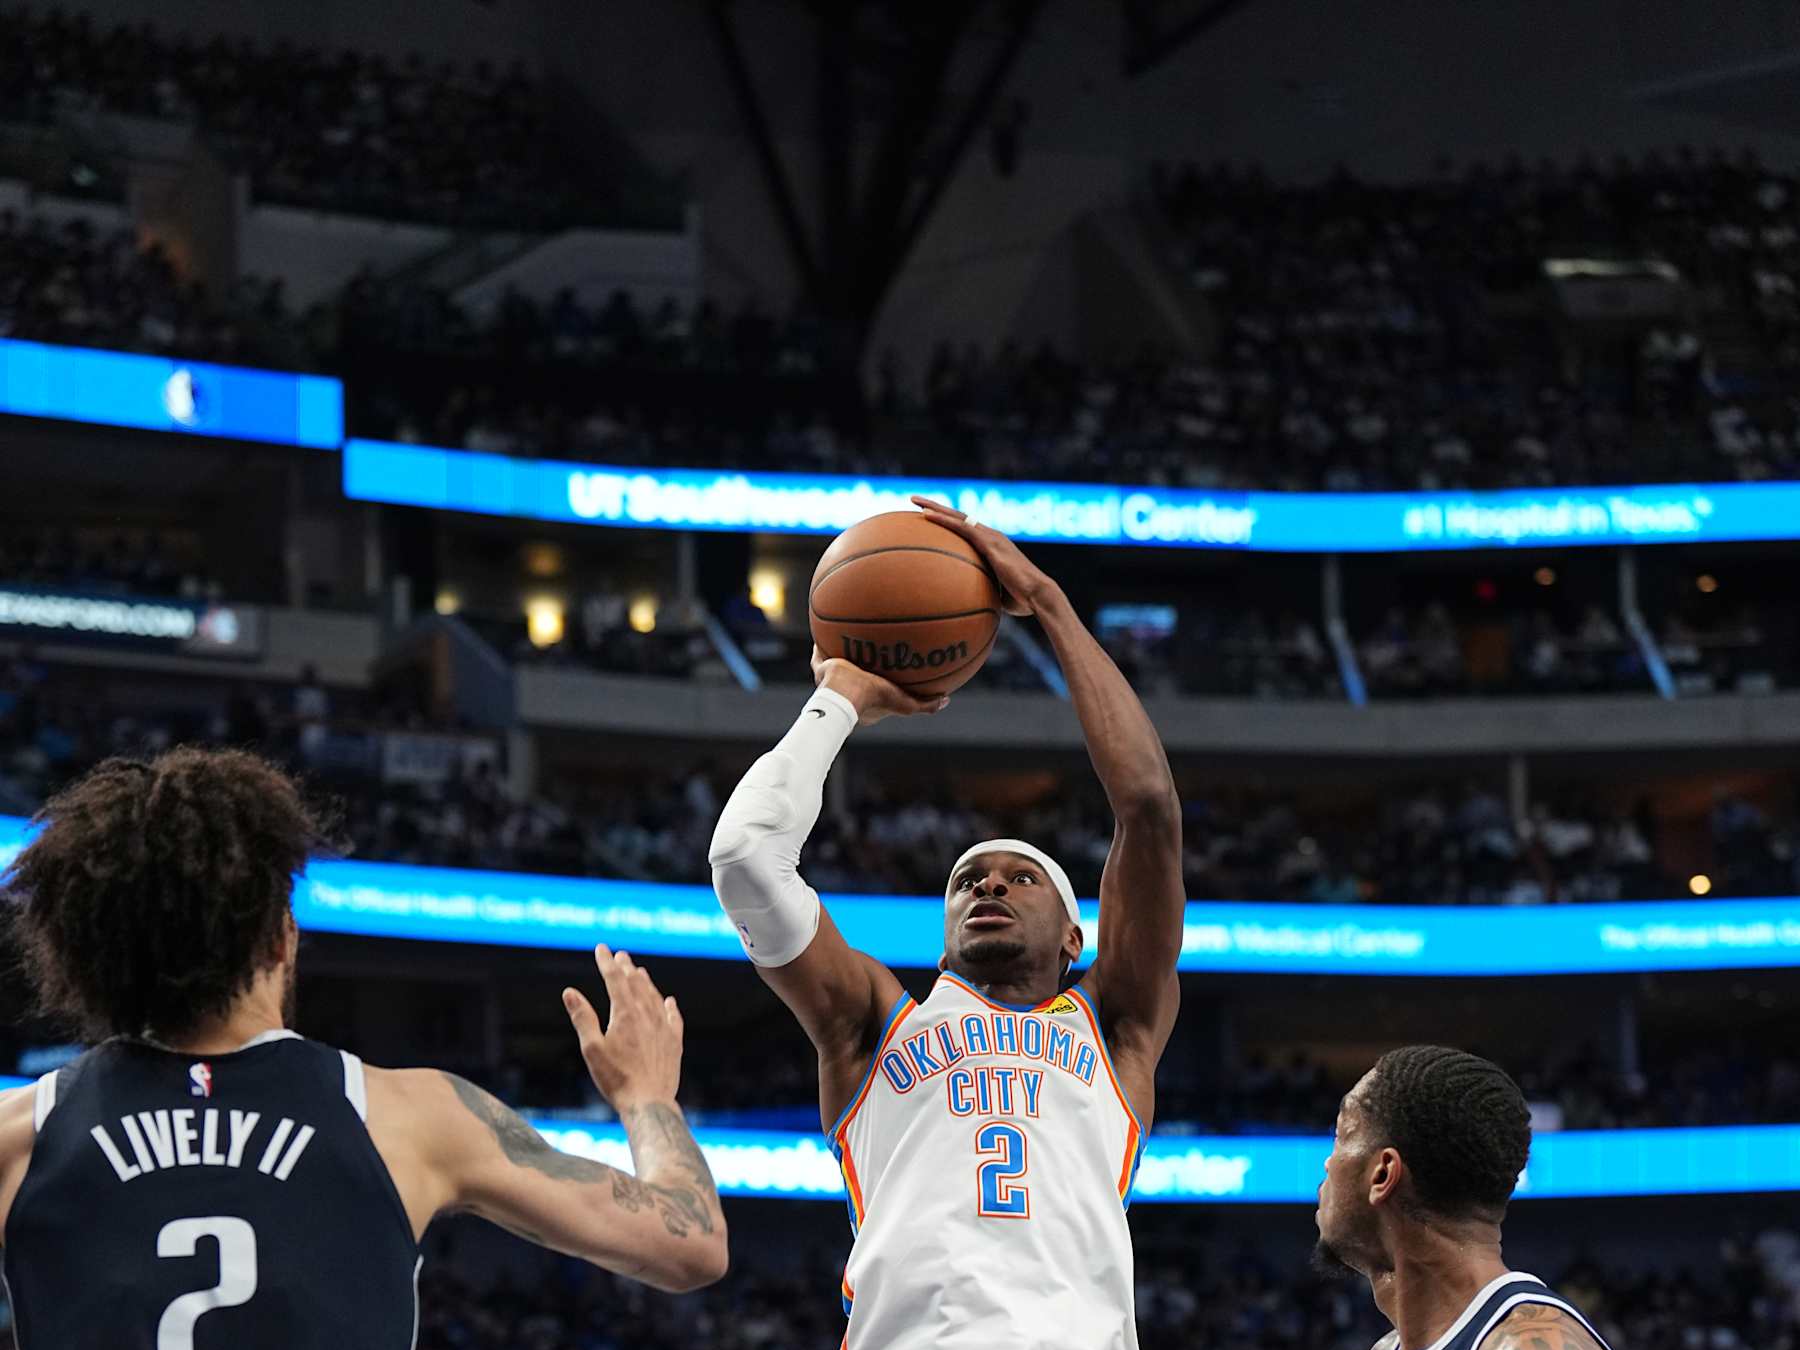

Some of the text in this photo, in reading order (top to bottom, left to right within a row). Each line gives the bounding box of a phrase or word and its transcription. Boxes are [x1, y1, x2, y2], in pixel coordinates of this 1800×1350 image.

[568, 473, 624, 519] UT
[1121, 493, 1256, 544] Center
[1446, 498, 1568, 544] Hospital
[842, 634, 968, 672] Wilson
[1232, 922, 1332, 955] Medical
[1333, 923, 1425, 957] Center
[880, 1013, 1098, 1094] OKLAHOMA
[947, 1067, 1043, 1117] CITY
[90, 1109, 316, 1182] LIVELY II
[976, 1121, 1030, 1219] 2
